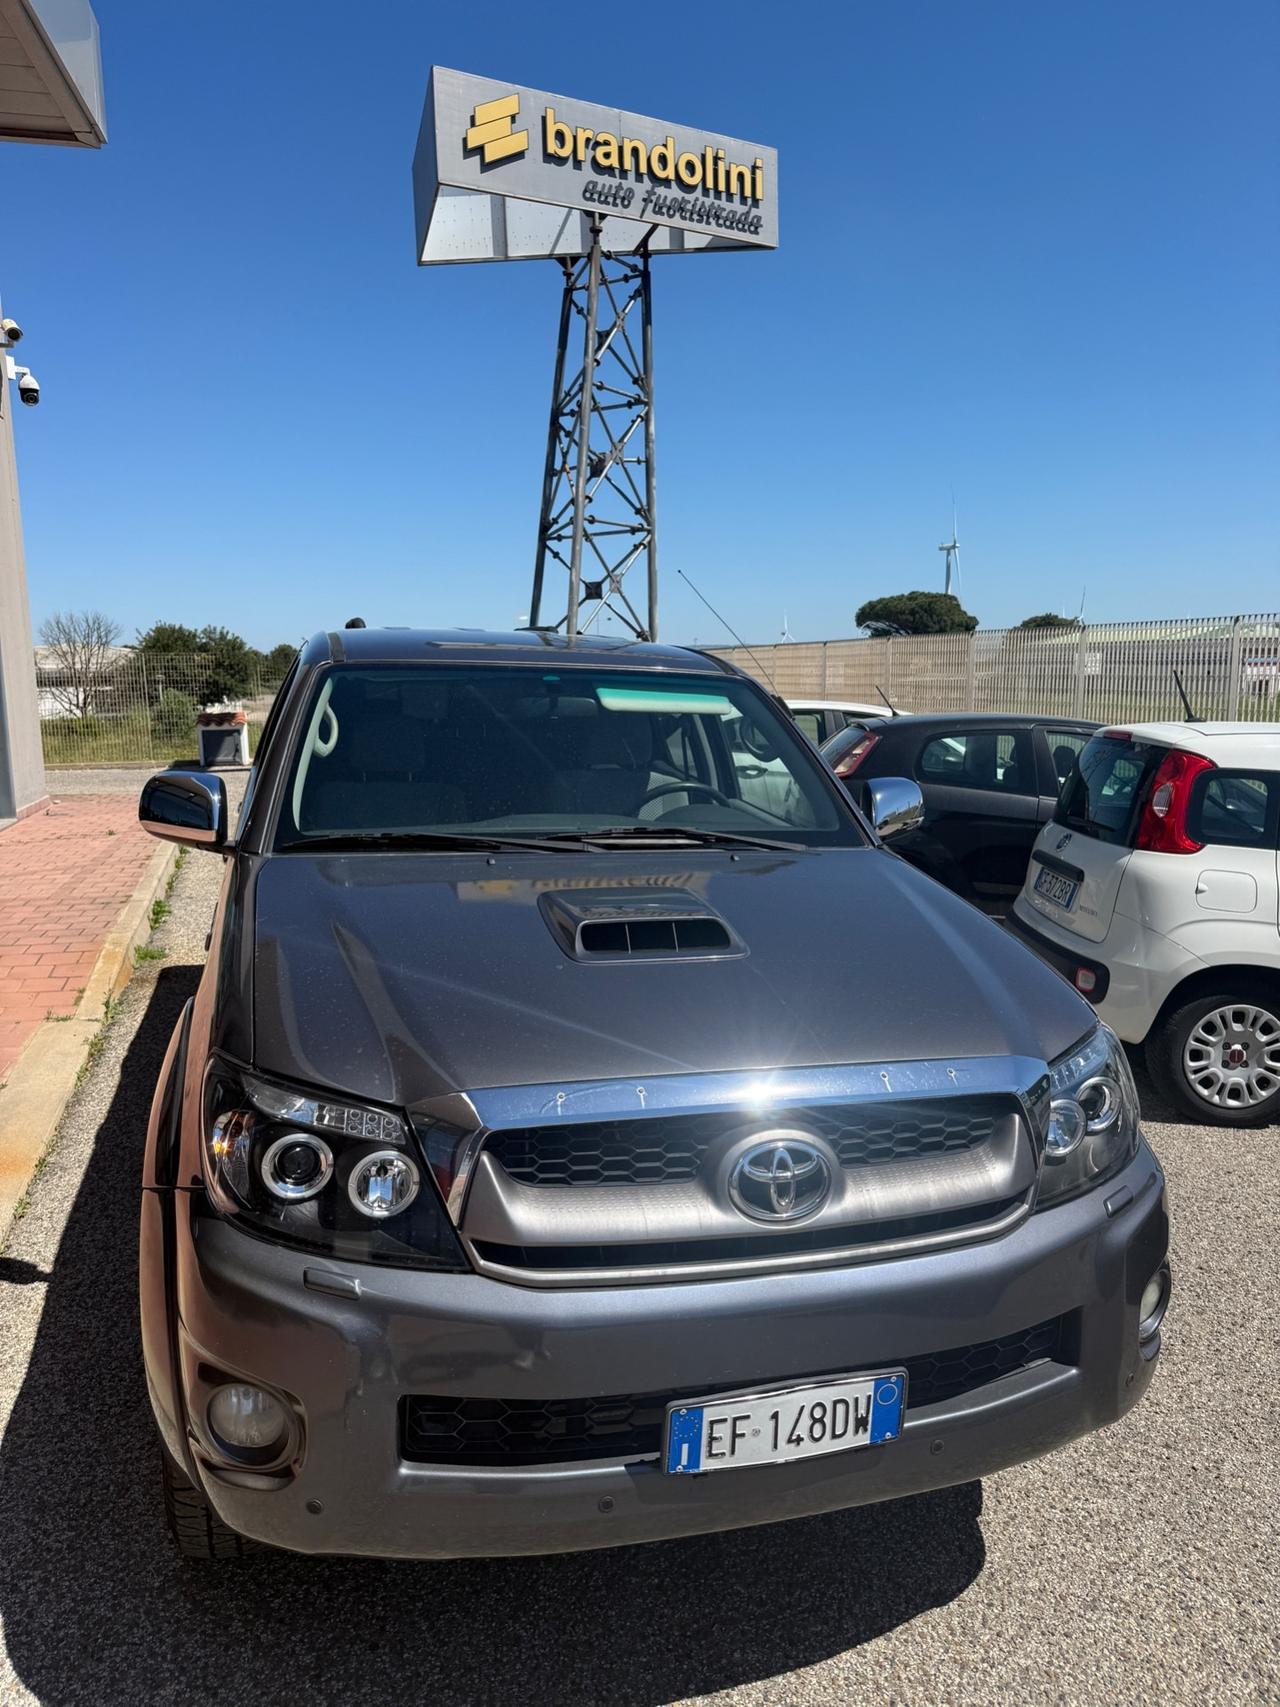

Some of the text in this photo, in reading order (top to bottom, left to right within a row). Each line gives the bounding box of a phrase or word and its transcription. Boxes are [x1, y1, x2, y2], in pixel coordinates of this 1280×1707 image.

[545, 107, 763, 201] brandolini
[584, 179, 635, 203] auto
[707, 1414, 751, 1458] EF
[769, 1392, 872, 1450] 148DW
